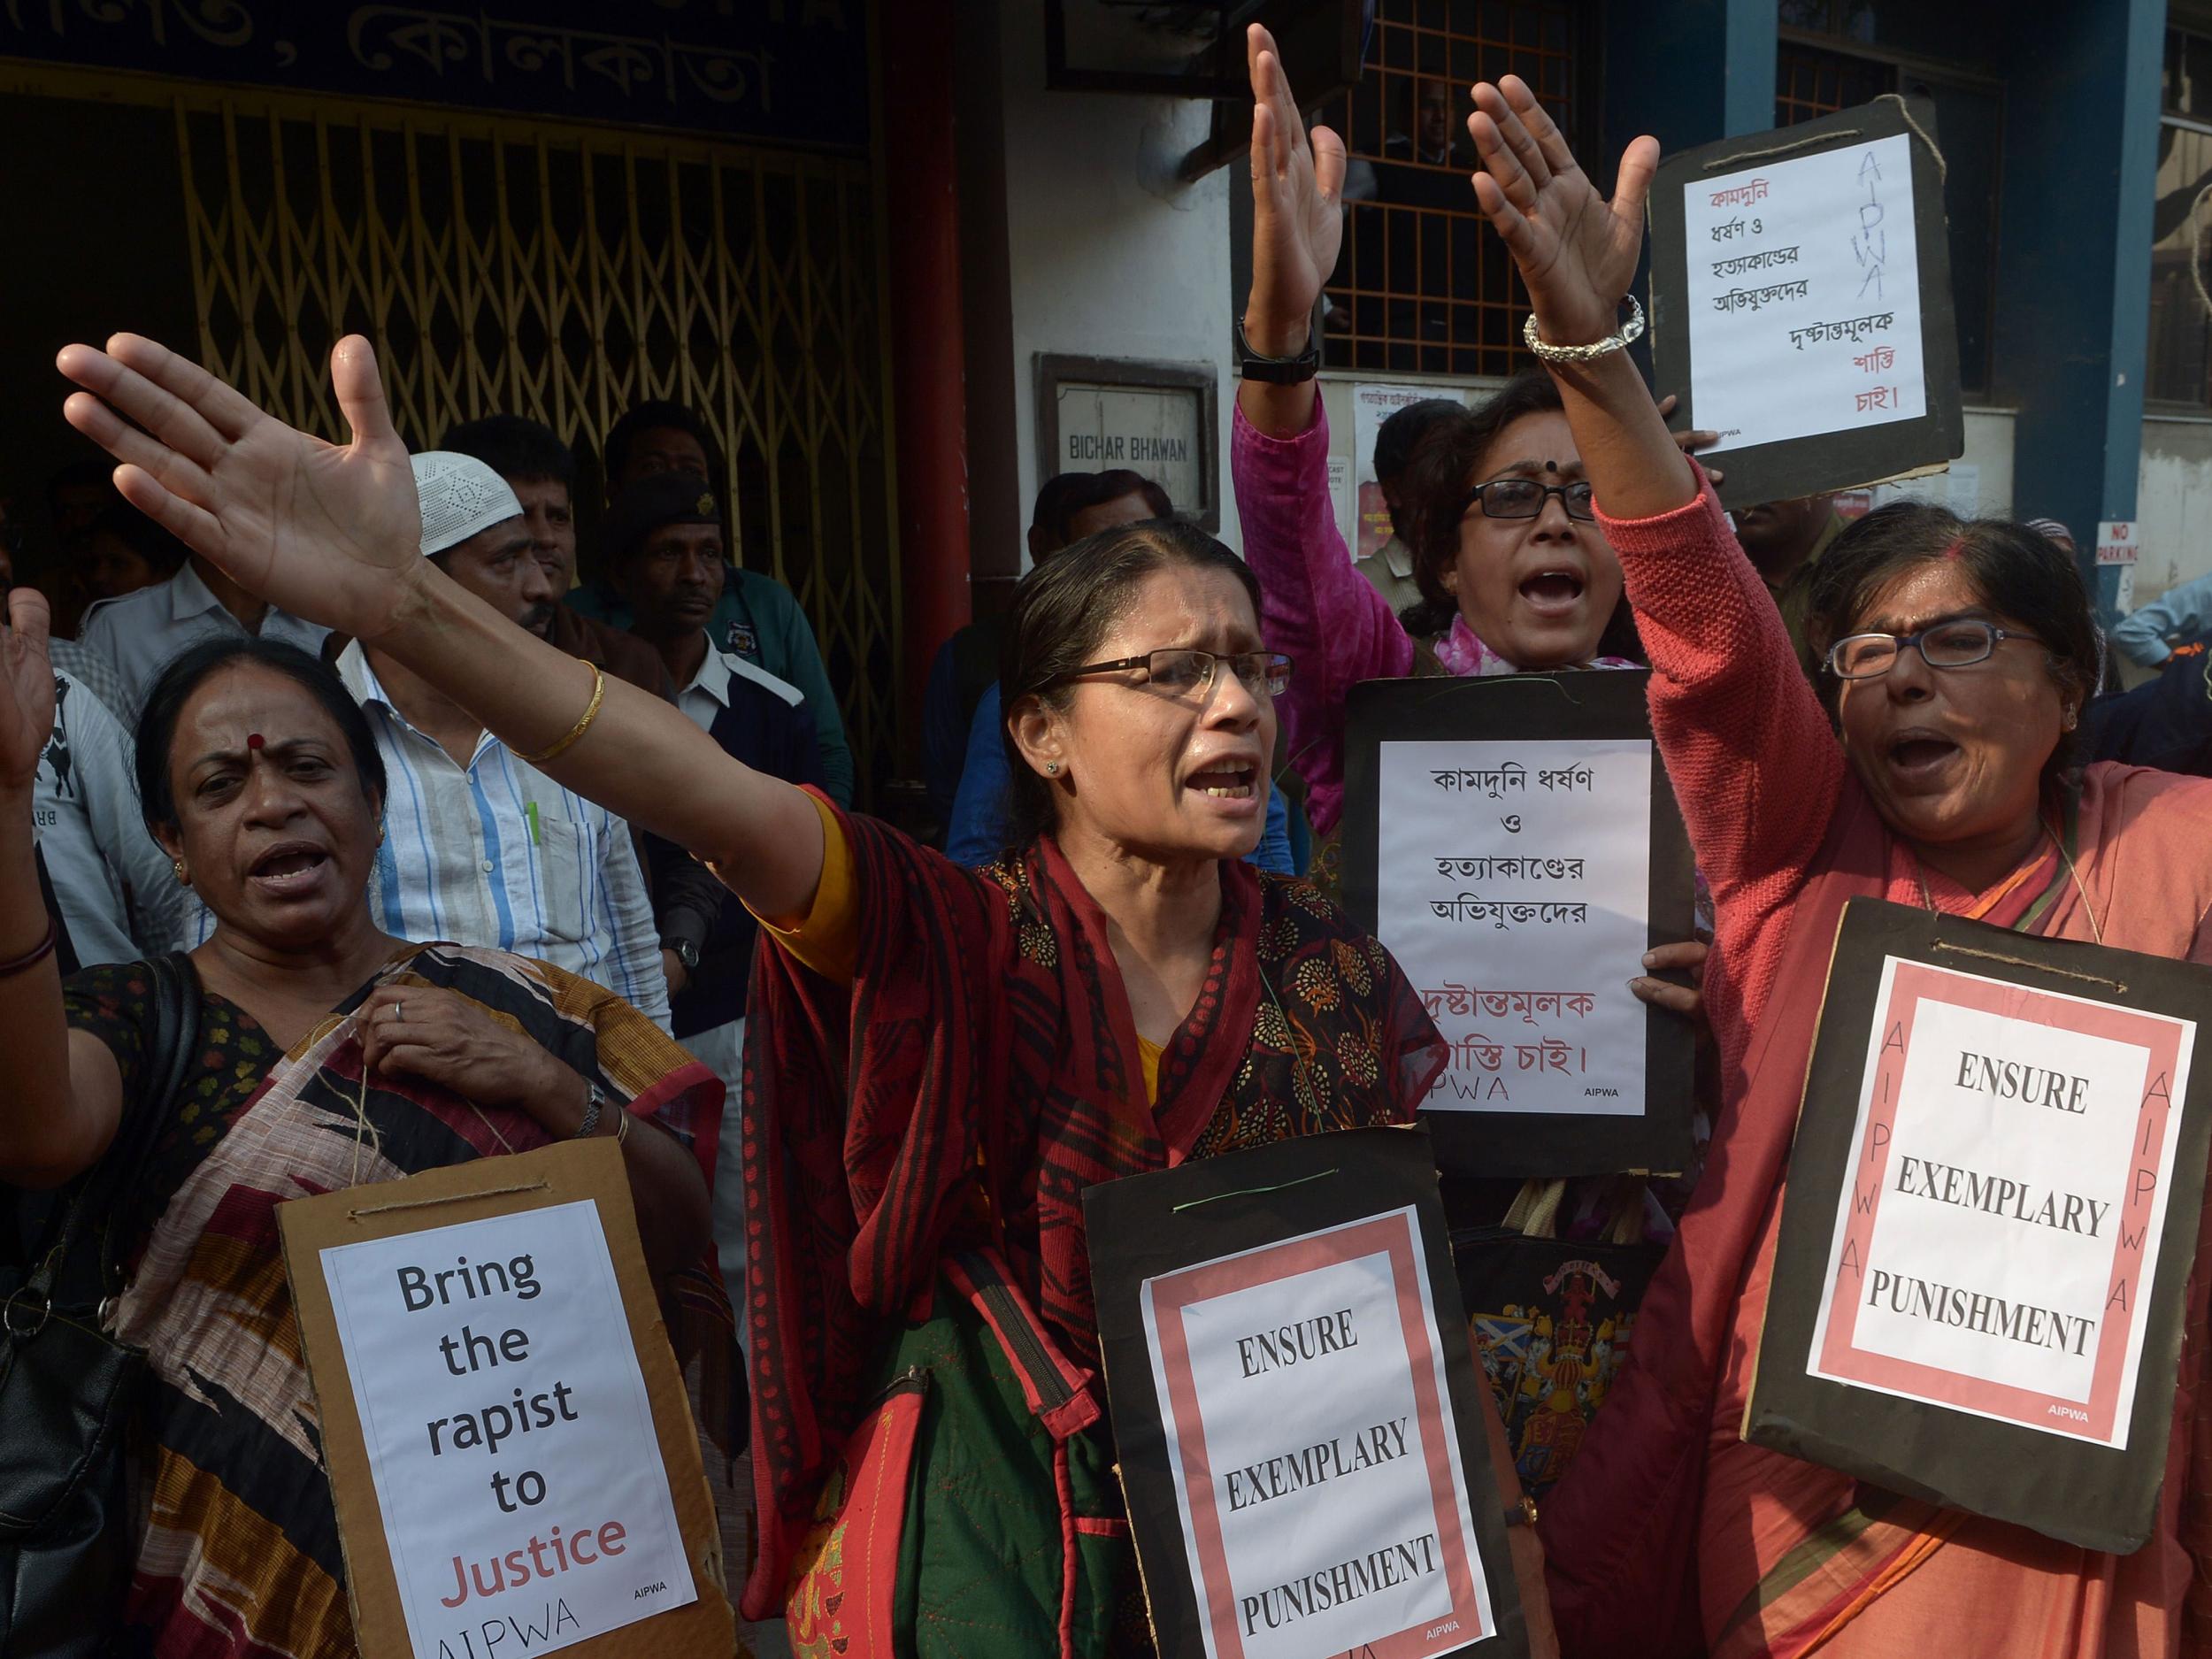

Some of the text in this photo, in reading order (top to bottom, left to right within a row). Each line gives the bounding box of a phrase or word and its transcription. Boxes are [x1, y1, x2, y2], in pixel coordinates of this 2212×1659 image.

[345, 4, 776, 112] কোলকাতা
[1709, 179, 1770, 207] কামদুনি
[1711, 216, 1763, 242] ধর্ষণ ও
[1712, 279, 1809, 314] অভিযুক্তদের
[1788, 311, 1894, 350] দৃষ্টান্তমূলক
[1853, 346, 1895, 374] শাস্তি
[1070, 434, 1187, 463] BICHAR BHAWAN
[1719, 429, 1741, 439] IPWA
[2111, 524, 2129, 541] NO
[1430, 761, 1594, 800] কামদুনি ধর্ষণ
[1500, 814, 1521, 833] ও
[1434, 856, 1586, 881] হত্যাকাণ্ডের
[1429, 892, 1588, 930] অভিযুক্তদের
[1584, 1087, 1619, 1098] AIPWA
[1955, 1050, 2091, 1115] ENSURE
[1837, 1021, 1904, 1280] AIPWA
[1895, 1155, 2110, 1238] EXEMPLARY
[2106, 1071, 2172, 1313] AIPWA
[396, 1253, 542, 1313] Bring
[1867, 1269, 2095, 1357] PUNISHMENT
[440, 1326, 530, 1376] the
[1236, 1309, 1358, 1379] ENSURE
[426, 1381, 579, 1456] rapist
[2047, 1404, 2090, 1424] AIPWA
[1225, 1417, 1409, 1512] EXEMPLARY
[490, 1470, 547, 1513] to
[440, 1520, 627, 1609] Justice
[634, 1581, 667, 1600] AIPWA
[1240, 1533, 1439, 1638] PUNISHMENT
[1426, 1620, 1460, 1640] AIPWA
